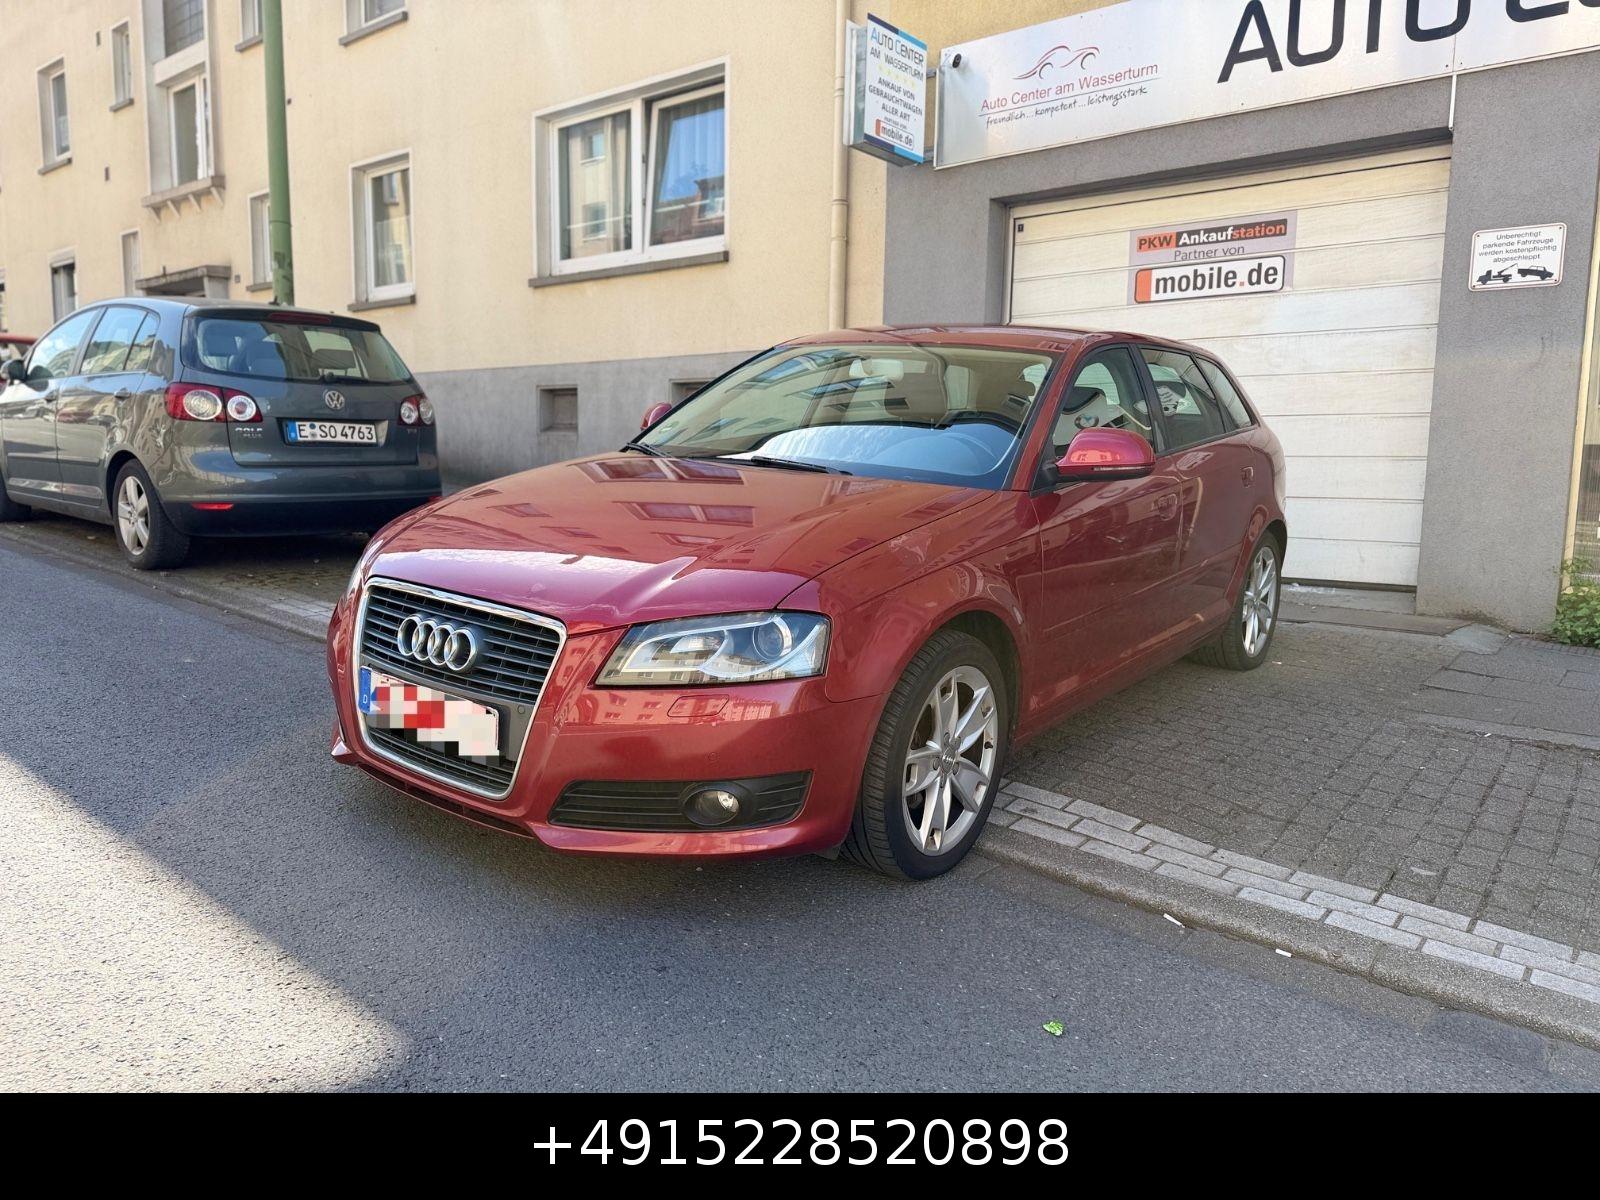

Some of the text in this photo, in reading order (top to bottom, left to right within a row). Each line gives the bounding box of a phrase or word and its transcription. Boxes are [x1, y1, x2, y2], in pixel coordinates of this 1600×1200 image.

[871, 28, 923, 67] AUTO CENTER
[870, 47, 923, 81] AM WASSERTURM
[878, 77, 915, 101] ANKAUF VON
[980, 64, 1158, 112] Auto Center am Wasserturm
[868, 85, 922, 116] GEBRAUCHTWAGEN
[881, 103, 911, 122] ALLER ART
[881, 126, 912, 146] mobile.de
[1138, 223, 1286, 250] PKW Ankaufstation
[1482, 237, 1554, 250] parkende Fahrzeuge
[1496, 231, 1541, 241] Unberechtigt
[1174, 245, 1245, 261] Partner von
[1478, 244, 1557, 257] werden kostenpflichtig
[1492, 253, 1541, 263] abgeschleppt
[1154, 262, 1279, 295] mobile.de
[298, 424, 374, 440] E SO 4763
